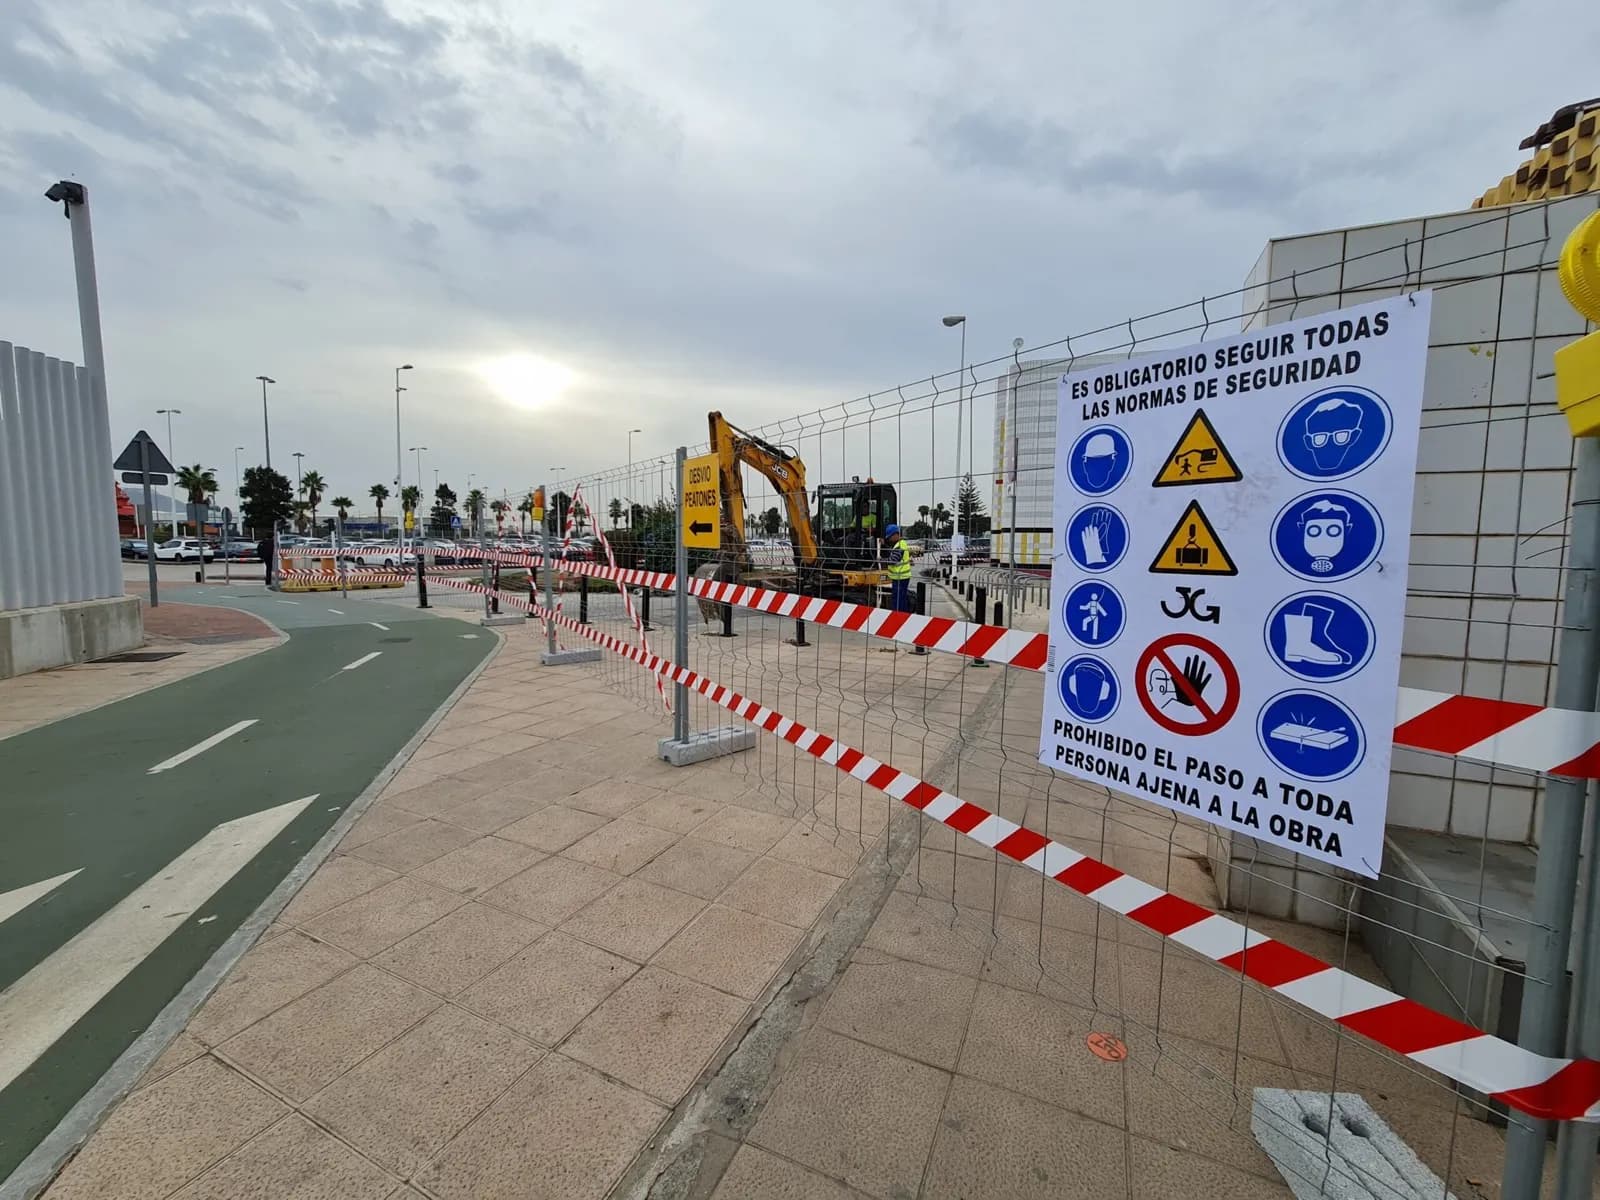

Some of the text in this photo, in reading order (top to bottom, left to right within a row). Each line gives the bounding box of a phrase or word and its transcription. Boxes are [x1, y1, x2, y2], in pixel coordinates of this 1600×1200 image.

[1072, 311, 1389, 400] ES OBLIGATORIO SEGUIR TODAS
[1082, 350, 1361, 421] LAS NORMAS DE SEGURIDAD
[685, 489, 716, 508] PEATONES
[689, 465, 711, 484] DESVIO
[771, 463, 788, 480] JCB
[1053, 719, 1354, 825] PROHIBIDO EL PASO A TODA
[1055, 744, 1342, 858] PERSONA AJENA A LA OBRA
